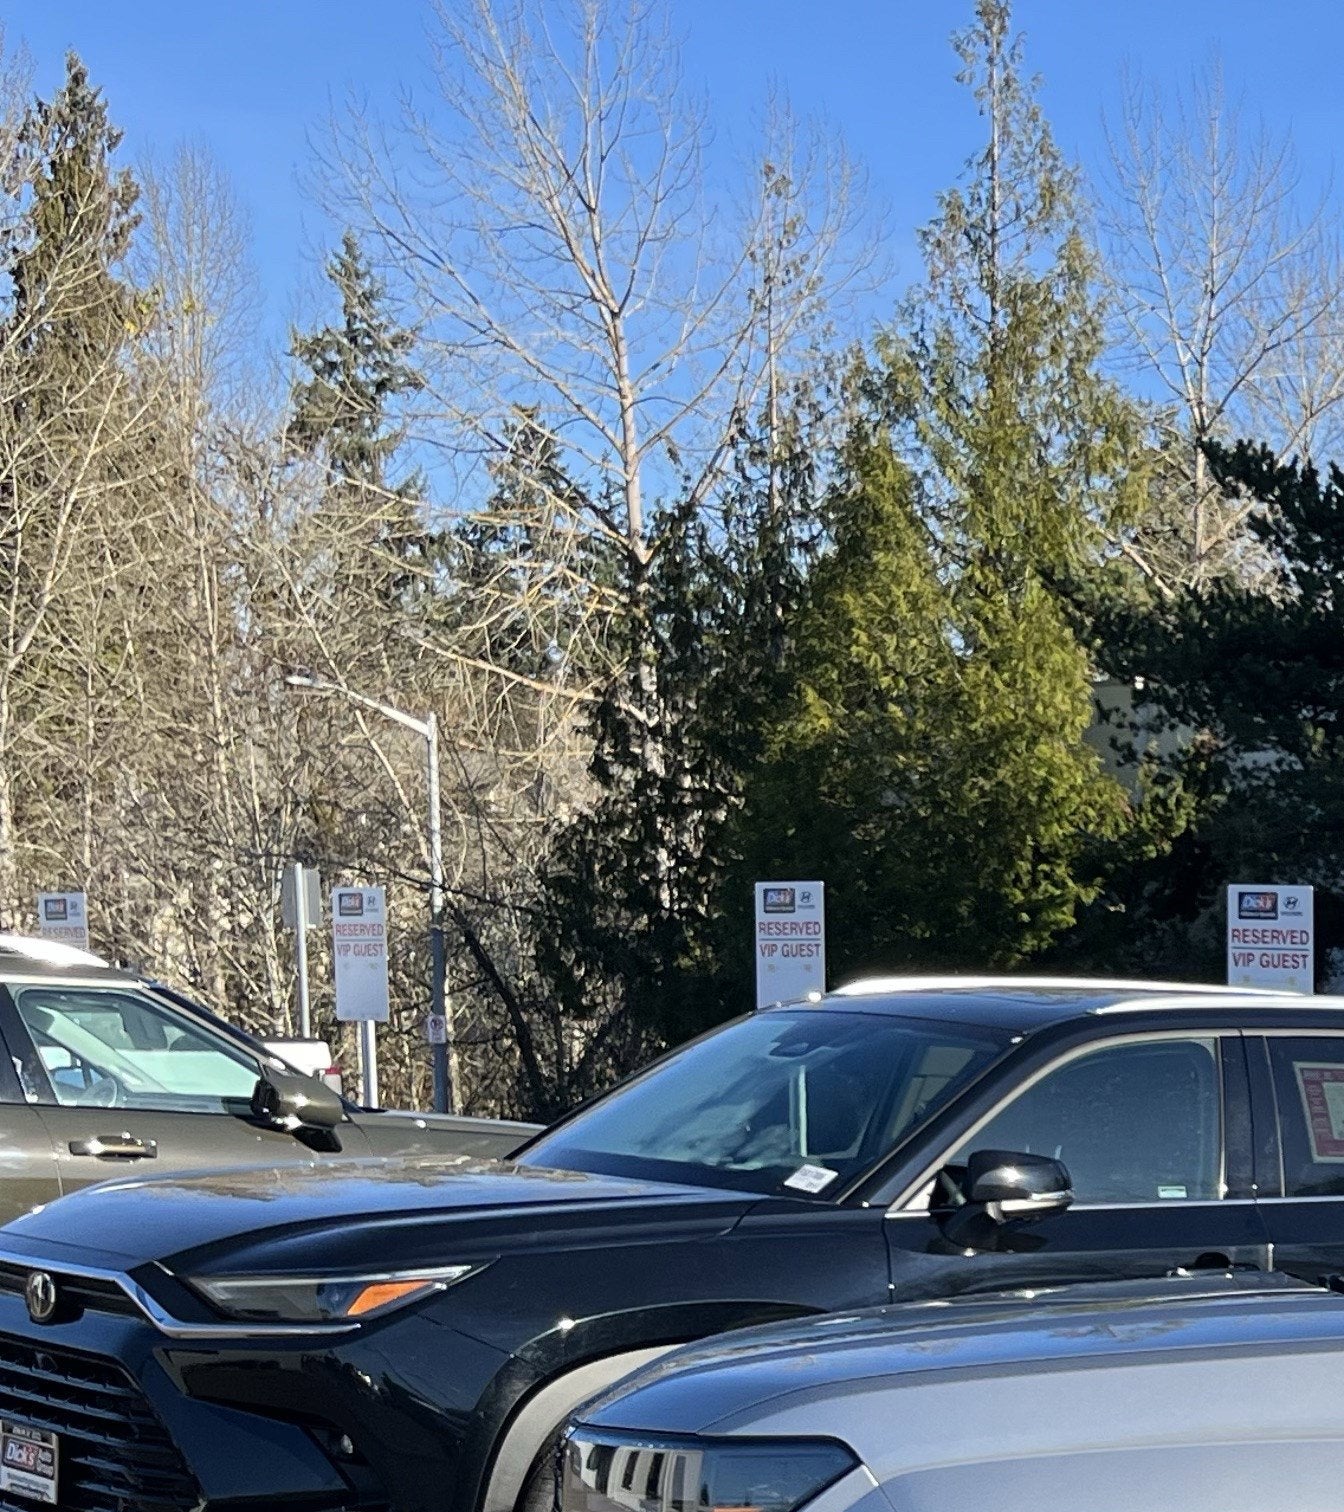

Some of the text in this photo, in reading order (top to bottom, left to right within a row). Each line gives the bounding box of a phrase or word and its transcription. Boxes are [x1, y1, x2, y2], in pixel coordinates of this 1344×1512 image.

[758, 921, 821, 936] RESERVED
[1231, 928, 1310, 945] RESERVED
[760, 943, 822, 958] VIP GUEST
[1232, 952, 1310, 970] VIP GUEST
